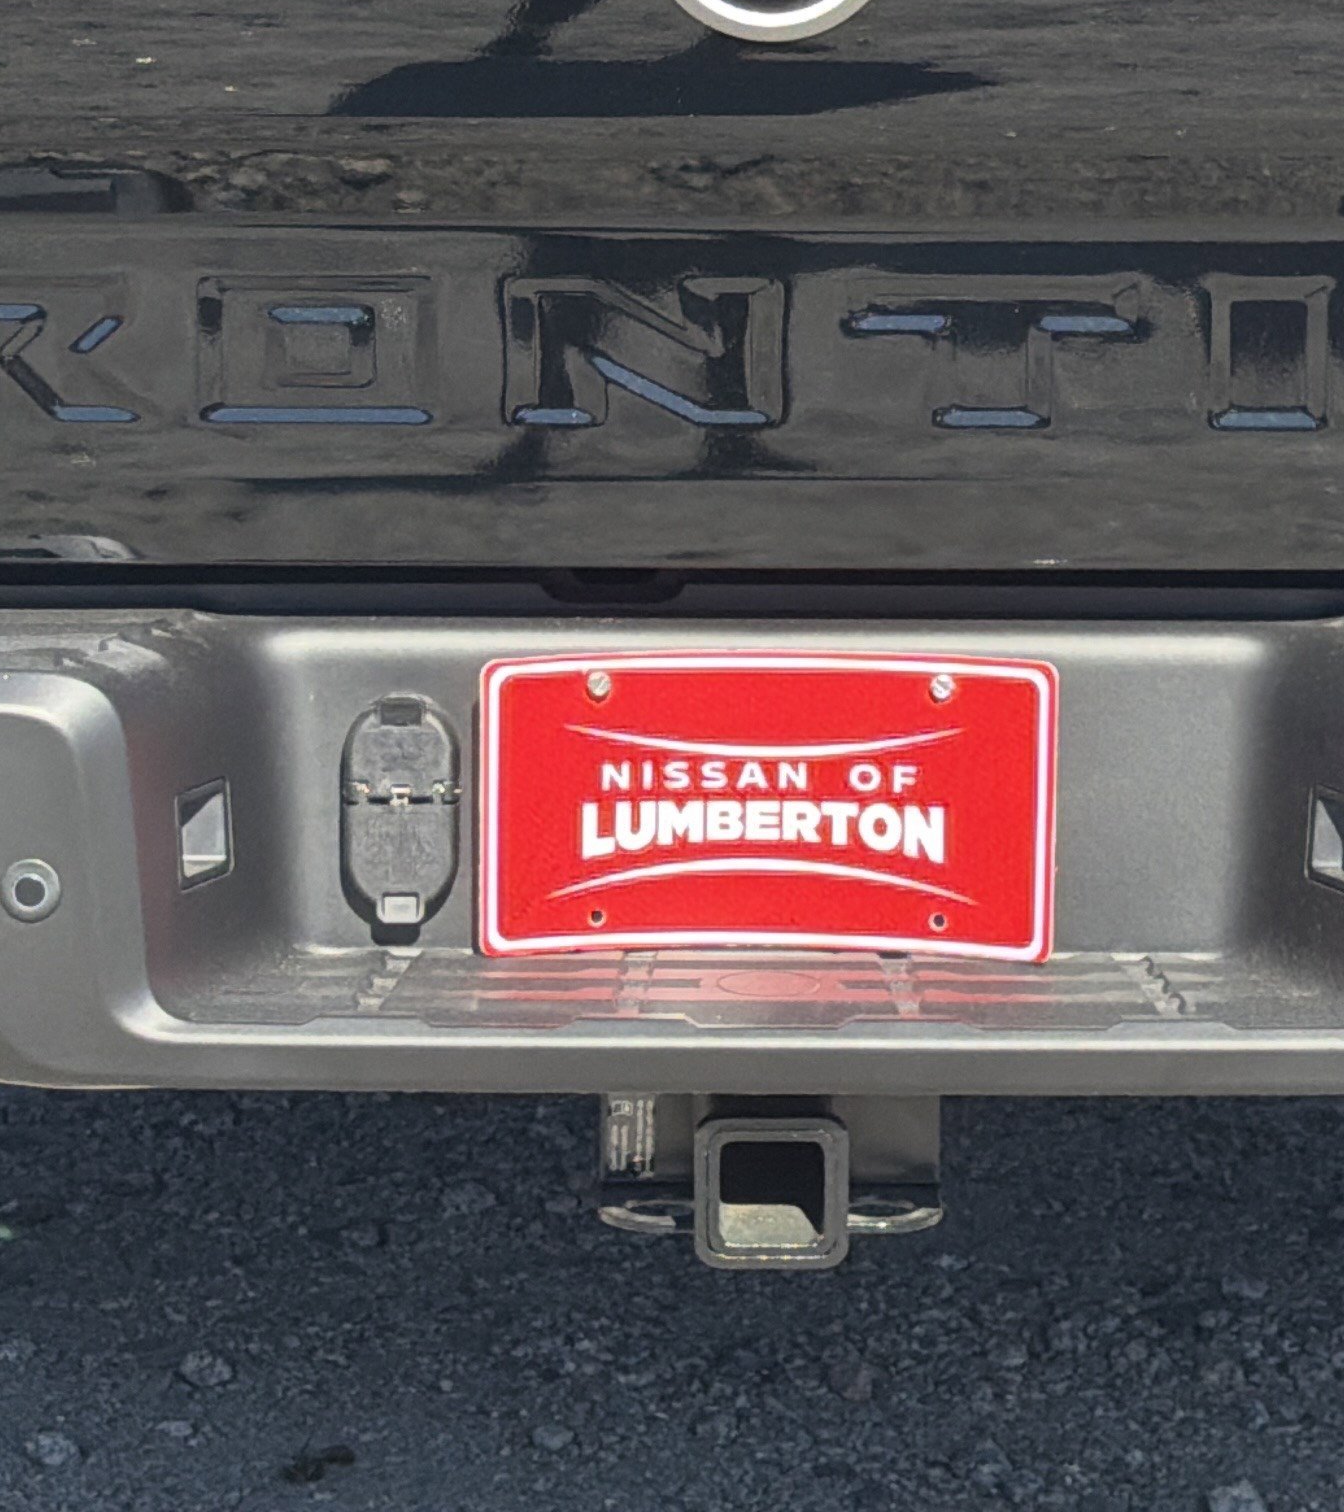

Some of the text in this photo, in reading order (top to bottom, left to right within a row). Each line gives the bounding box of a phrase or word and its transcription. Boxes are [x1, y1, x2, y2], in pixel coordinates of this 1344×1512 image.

[600, 759, 920, 793] NISSAN OF
[579, 798, 947, 864] LUMBERTON
